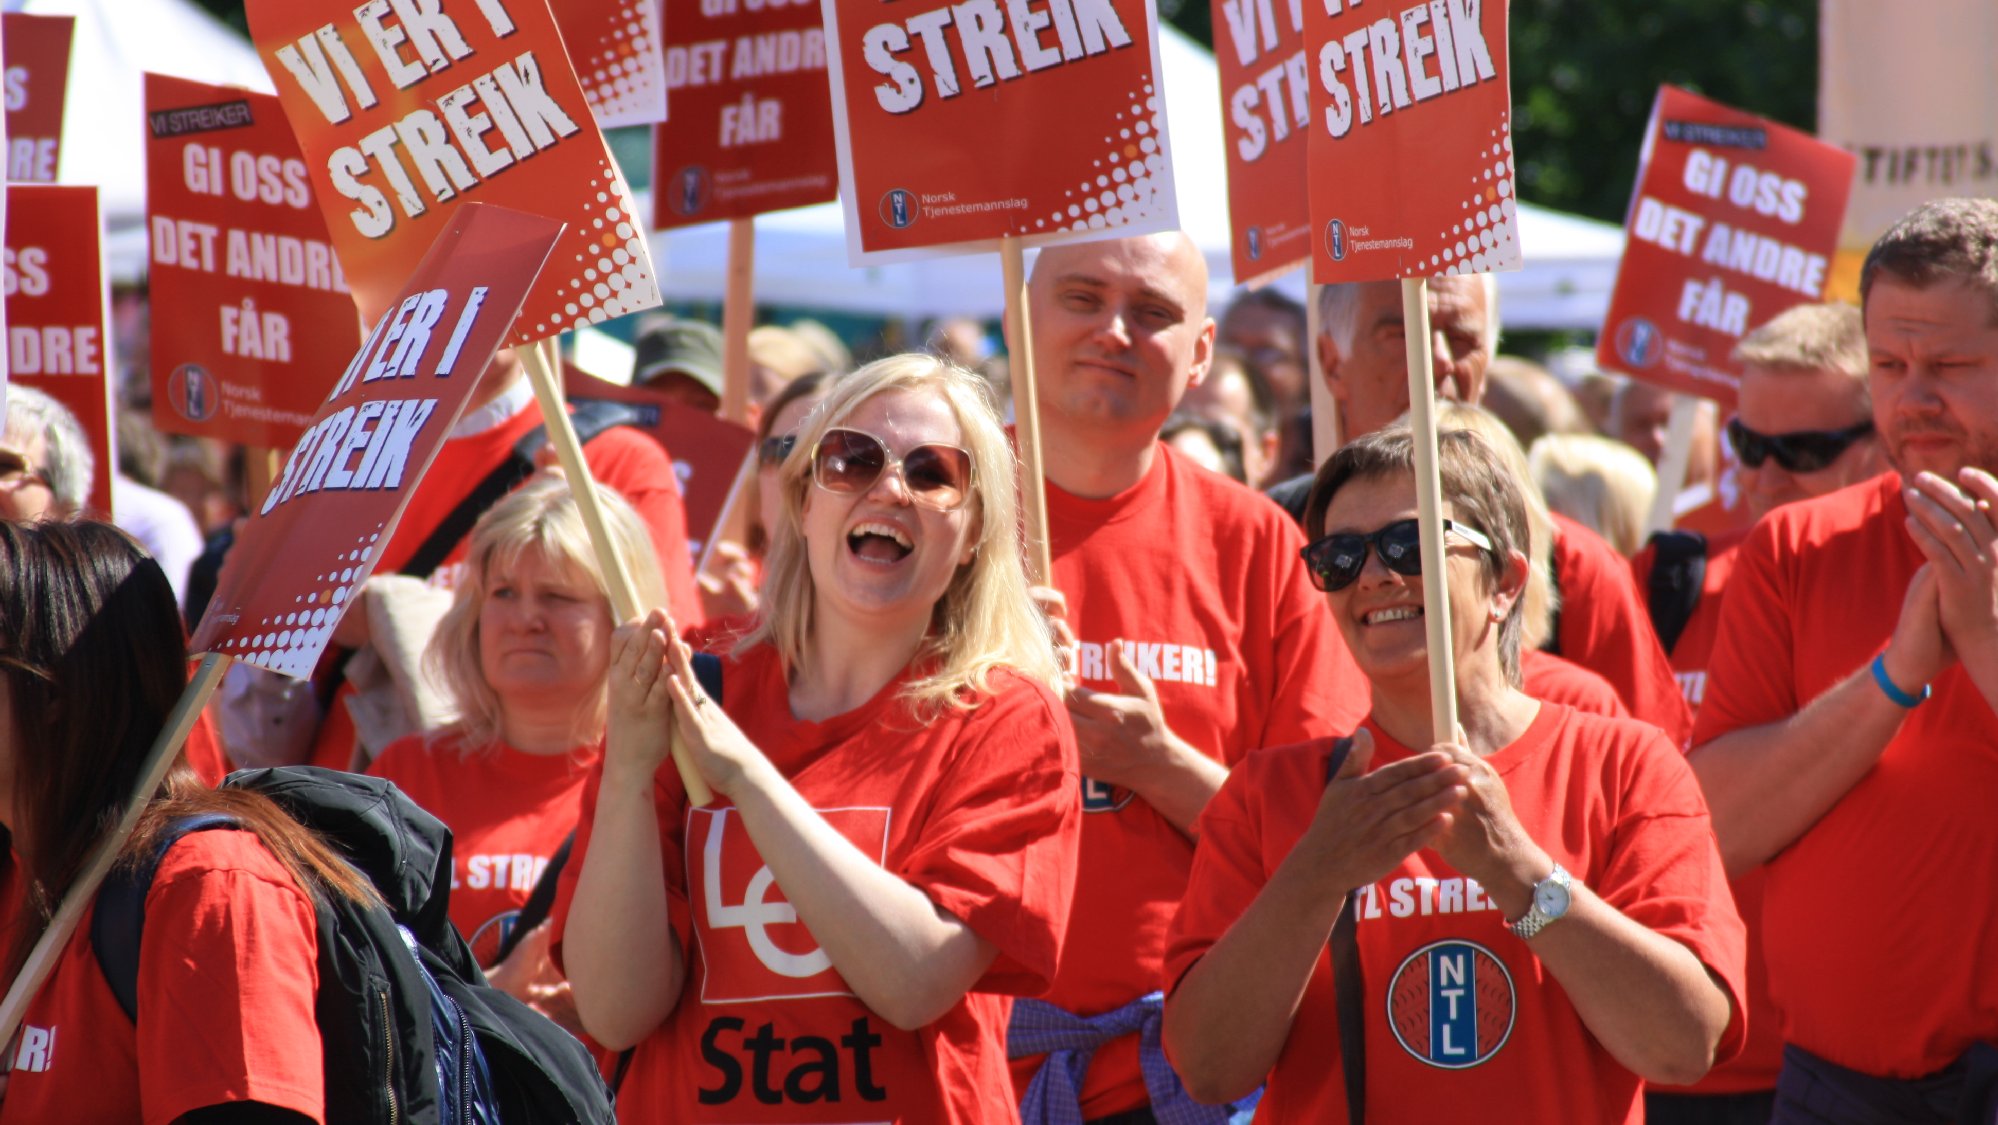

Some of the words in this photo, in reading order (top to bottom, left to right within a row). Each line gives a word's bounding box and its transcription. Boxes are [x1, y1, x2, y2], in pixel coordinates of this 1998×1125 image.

[274, 23, 379, 125] VI
[352, 0, 475, 90] ER
[667, 40, 727, 88] DET
[862, 0, 1133, 115] STREIK
[1319, 0, 1497, 138] STREIK
[169, 104, 252, 134] STREIKER
[327, 50, 580, 239] STREIK
[718, 91, 782, 148] FÅR
[5, 138, 56, 182] RE
[182, 142, 224, 196] GI
[230, 150, 310, 210] OSS
[1682, 147, 1730, 200] GI
[1728, 164, 1808, 226] OSS
[892, 192, 905, 225] NTL
[922, 191, 956, 204] Norsk
[922, 197, 1029, 218] Tjenestemannslag
[151, 214, 218, 273] DET
[1332, 223, 1342, 258] NTL
[1350, 224, 1370, 236] Norsk
[1351, 236, 1414, 253] Tjenestemannslag
[1633, 196, 1706, 257] DET
[1701, 222, 1828, 298] ANDRE
[219, 296, 292, 364] FÅR
[362, 288, 448, 385] ER
[1677, 276, 1750, 337] FÅR
[221, 380, 261, 400] Norsk
[259, 398, 439, 517] STREIK
[1439, 954, 1466, 1056] NTL
[697, 1016, 887, 1106] Stat
